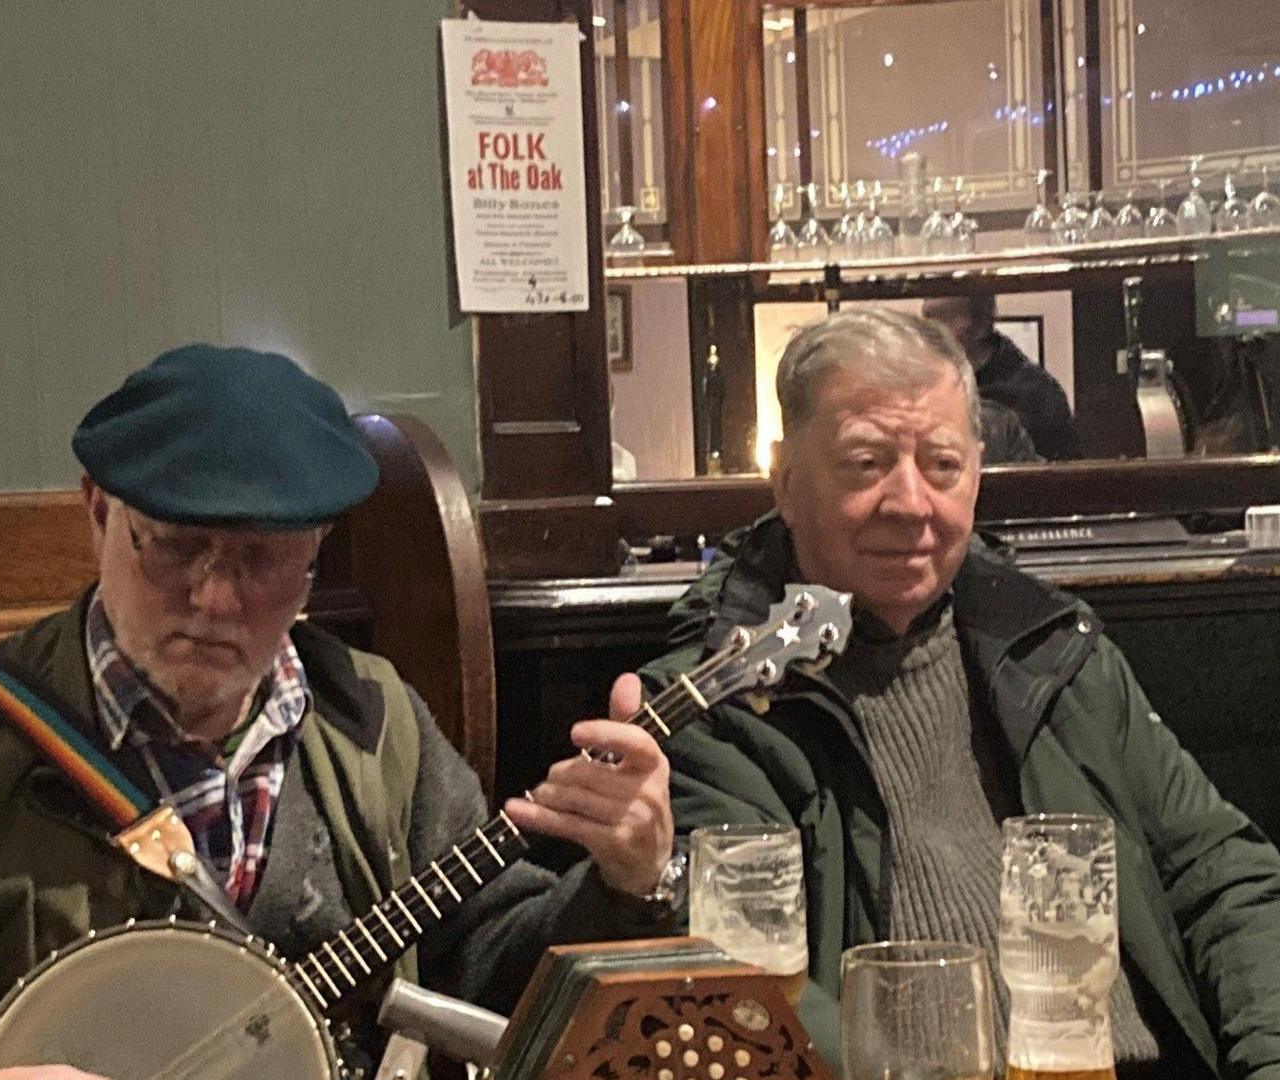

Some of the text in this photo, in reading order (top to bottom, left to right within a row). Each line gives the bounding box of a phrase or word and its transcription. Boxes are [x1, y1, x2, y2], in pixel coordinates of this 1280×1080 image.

[478, 131, 547, 161] FOLK
[467, 162, 563, 191] at The Oak
